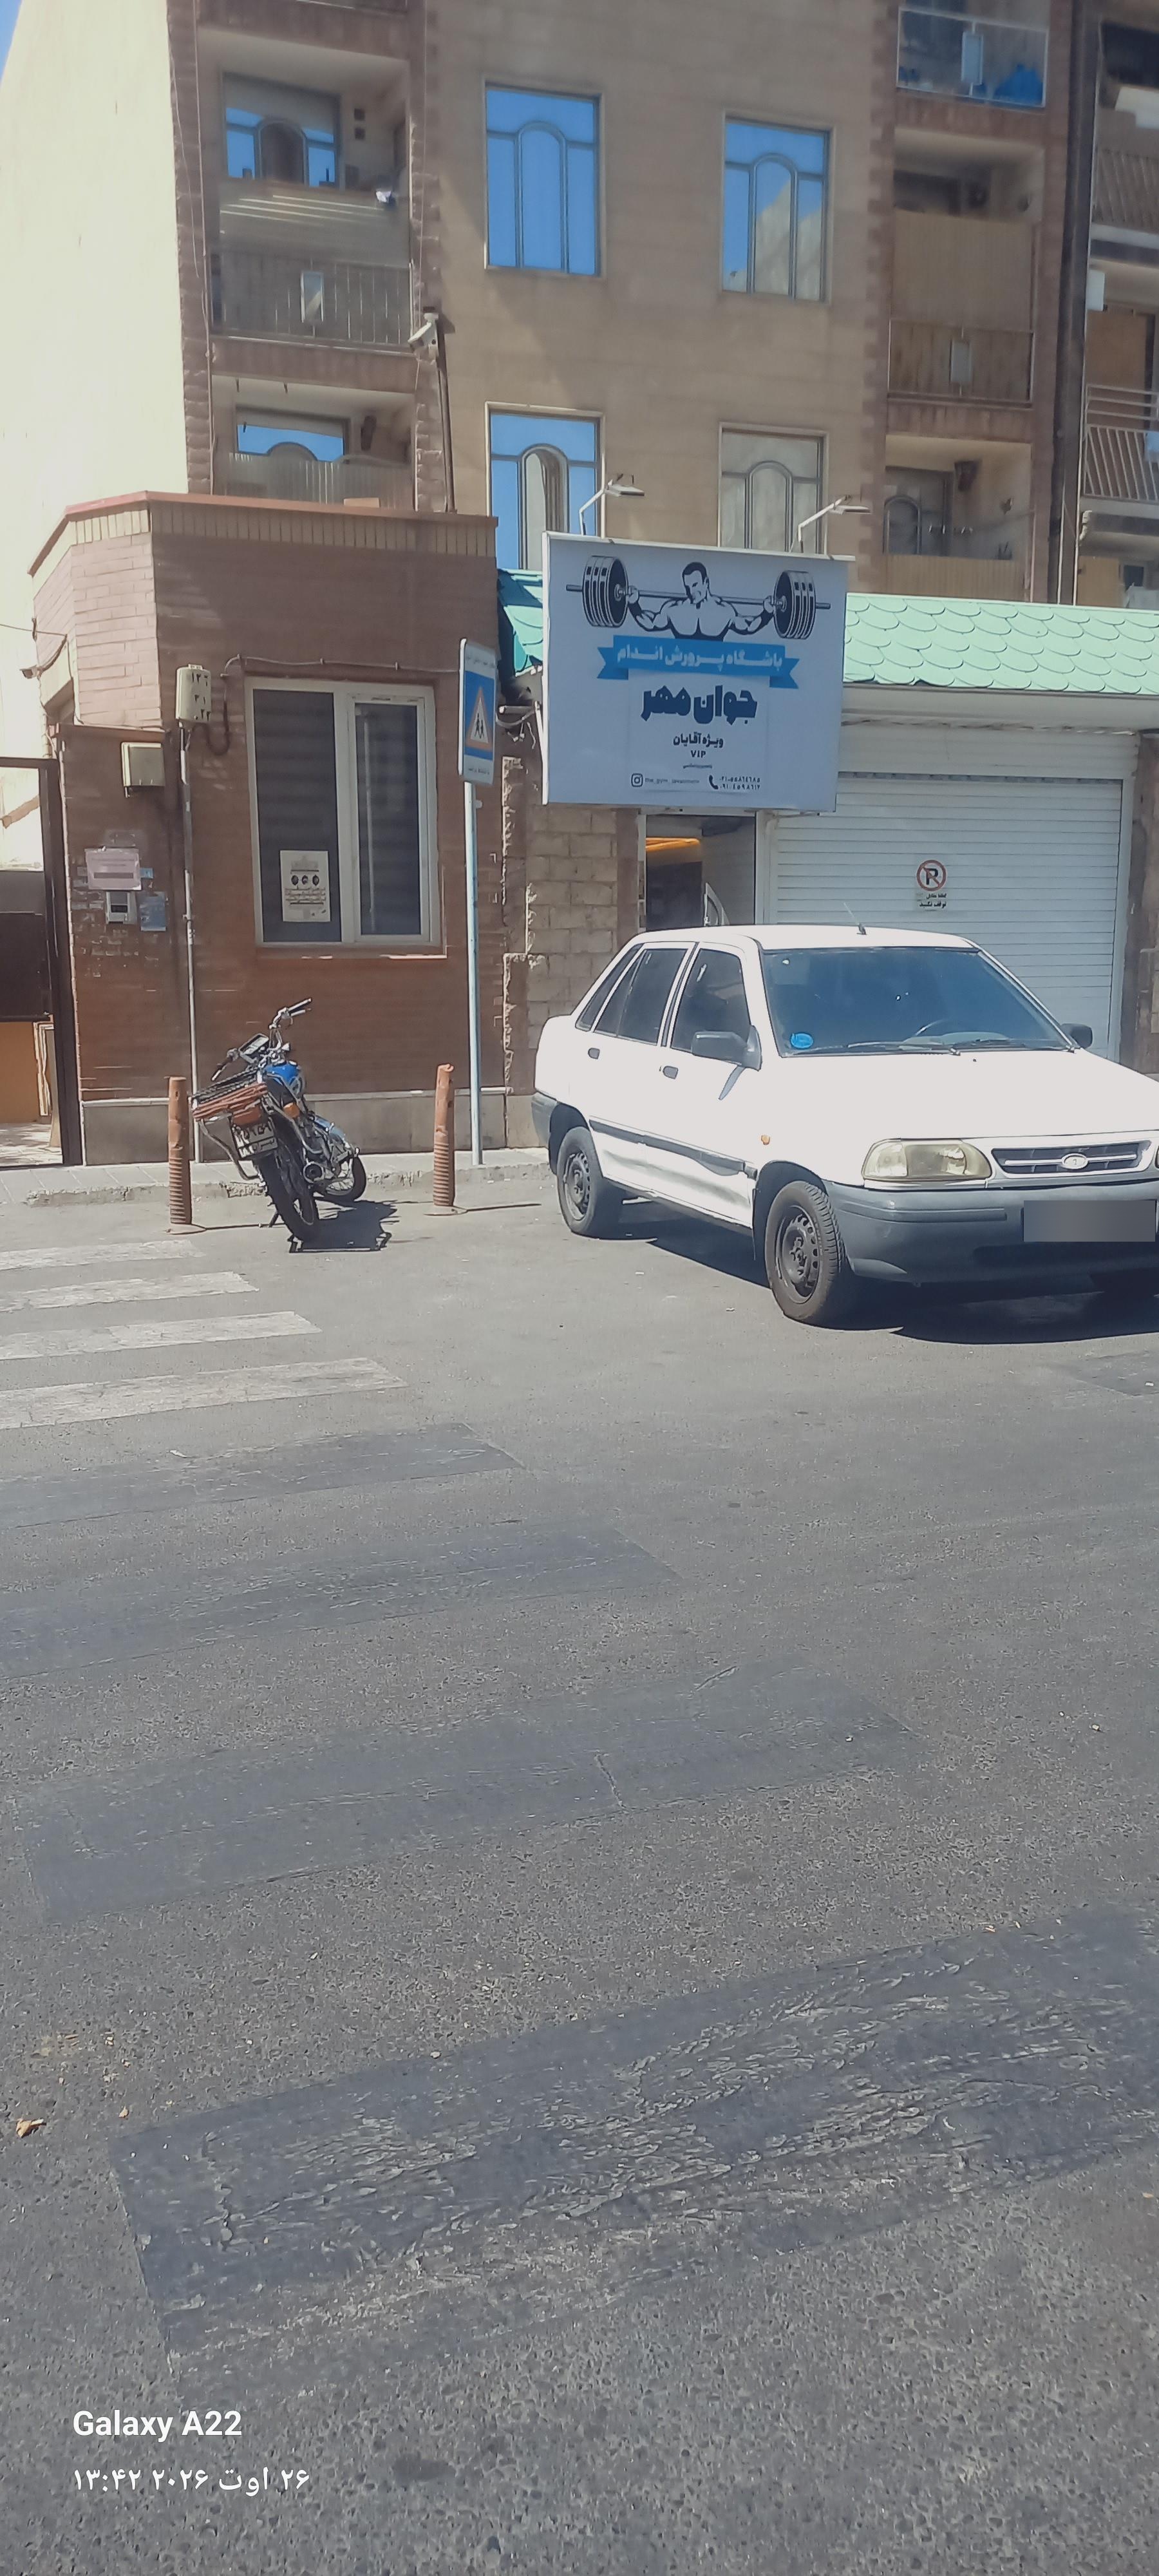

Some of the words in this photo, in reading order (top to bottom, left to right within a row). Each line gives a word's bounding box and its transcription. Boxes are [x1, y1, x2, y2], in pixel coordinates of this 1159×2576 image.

[617, 643, 663, 663] اندام
[665, 644, 724, 672] پرورش
[726, 649, 782, 672] باشگاه
[641, 685, 691, 722] مهر
[693, 685, 758, 725] جوان
[673, 732, 701, 747] آقایان
[702, 733, 724, 748] ویژه
[690, 750, 706, 758] VIP
